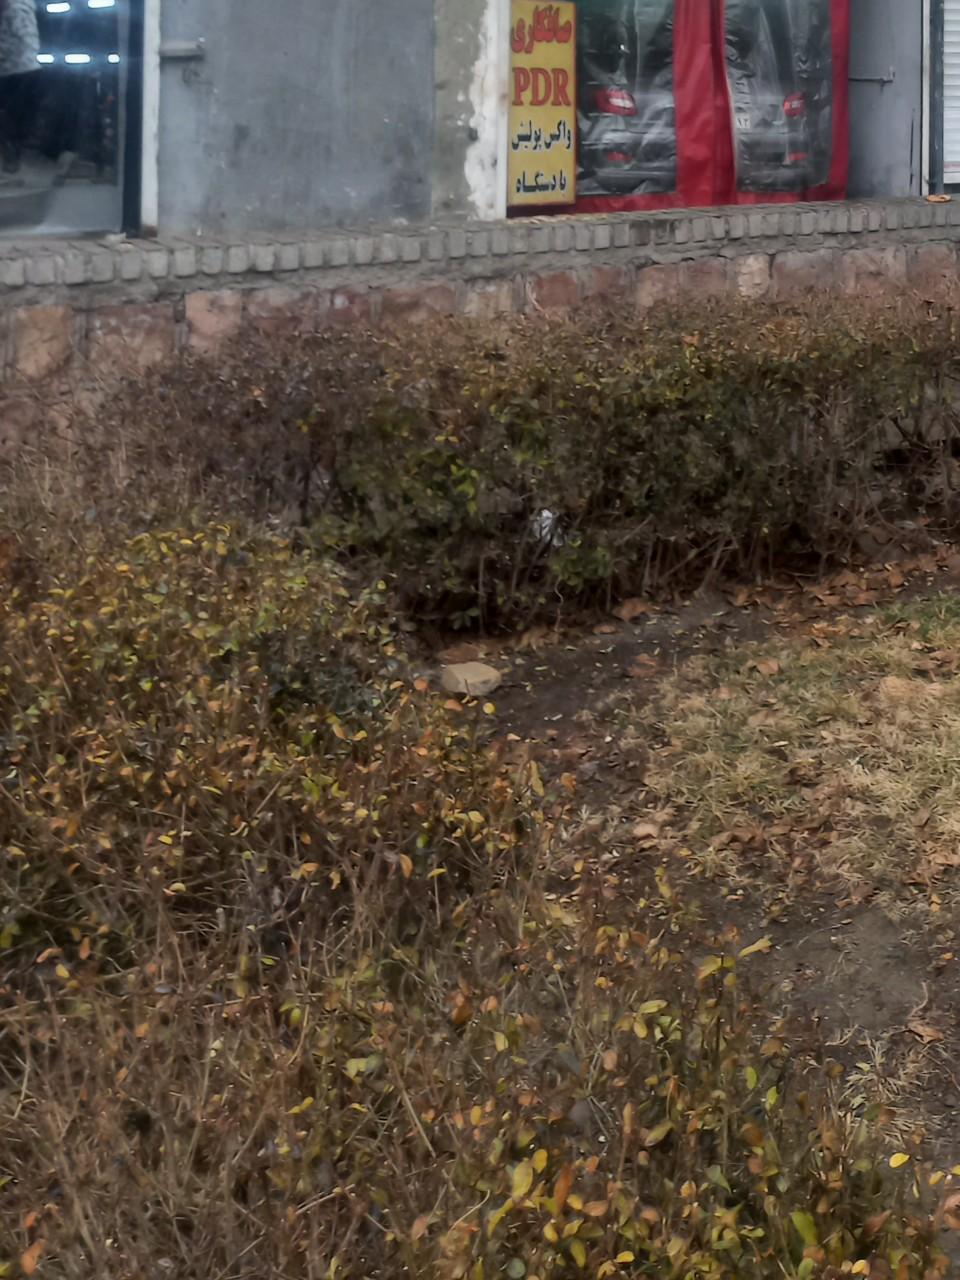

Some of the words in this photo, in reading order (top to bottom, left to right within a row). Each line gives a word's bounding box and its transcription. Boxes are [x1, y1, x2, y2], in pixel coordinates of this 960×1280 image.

[511, 4, 572, 54] صافکاری
[512, 67, 571, 106] PDR
[544, 119, 571, 150] واکس
[516, 170, 557, 194] دستگاه
[559, 169, 567, 196] با
